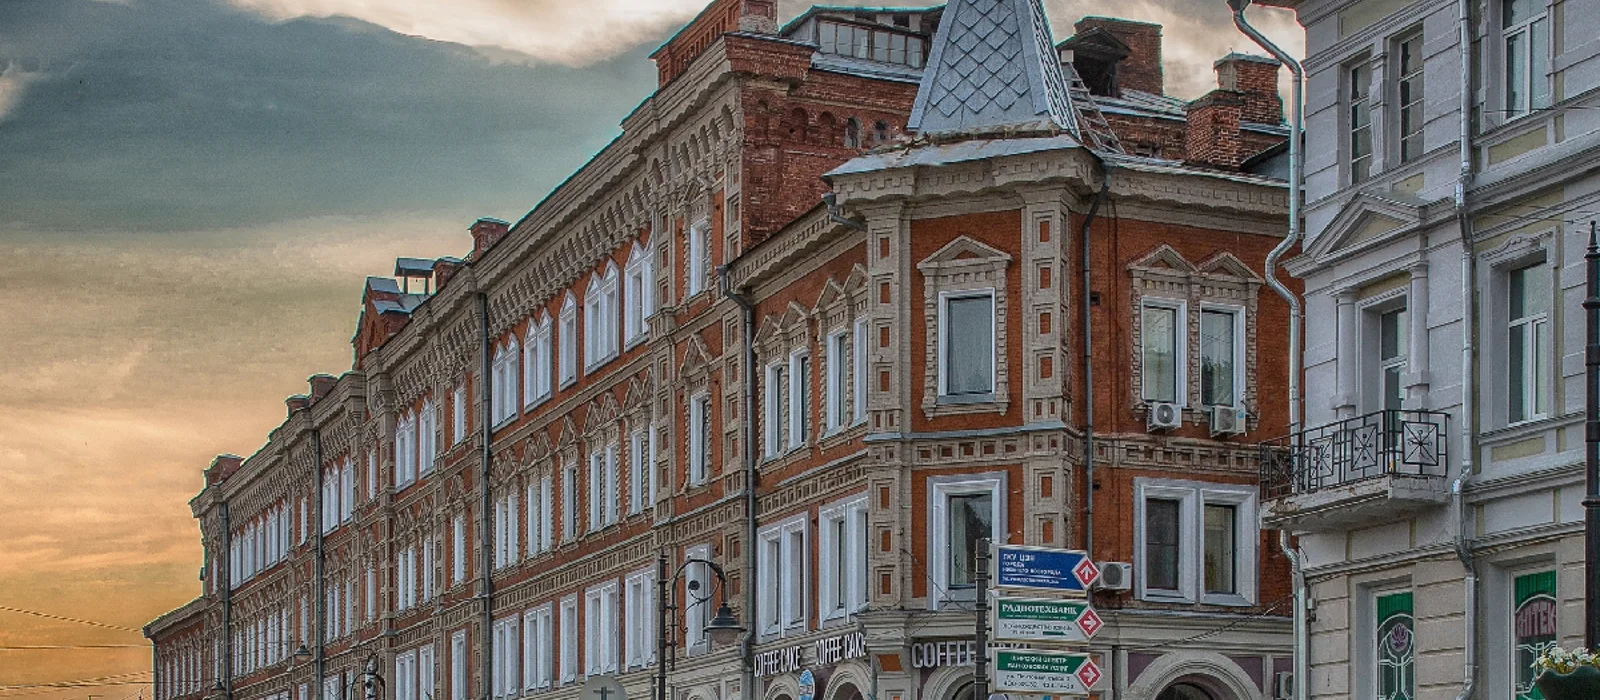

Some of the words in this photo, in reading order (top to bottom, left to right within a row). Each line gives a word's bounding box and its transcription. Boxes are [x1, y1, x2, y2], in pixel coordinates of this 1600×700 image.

[1002, 604, 1078, 615] РАДИОТЕХБАНК
[1516, 600, 1557, 637] АПТЕК
[754, 650, 780, 677] COFFEE
[780, 645, 801, 673] CAKE
[816, 636, 842, 666] COFFEE
[844, 631, 867, 659] CAKE
[911, 640, 977, 668] COFFEE
